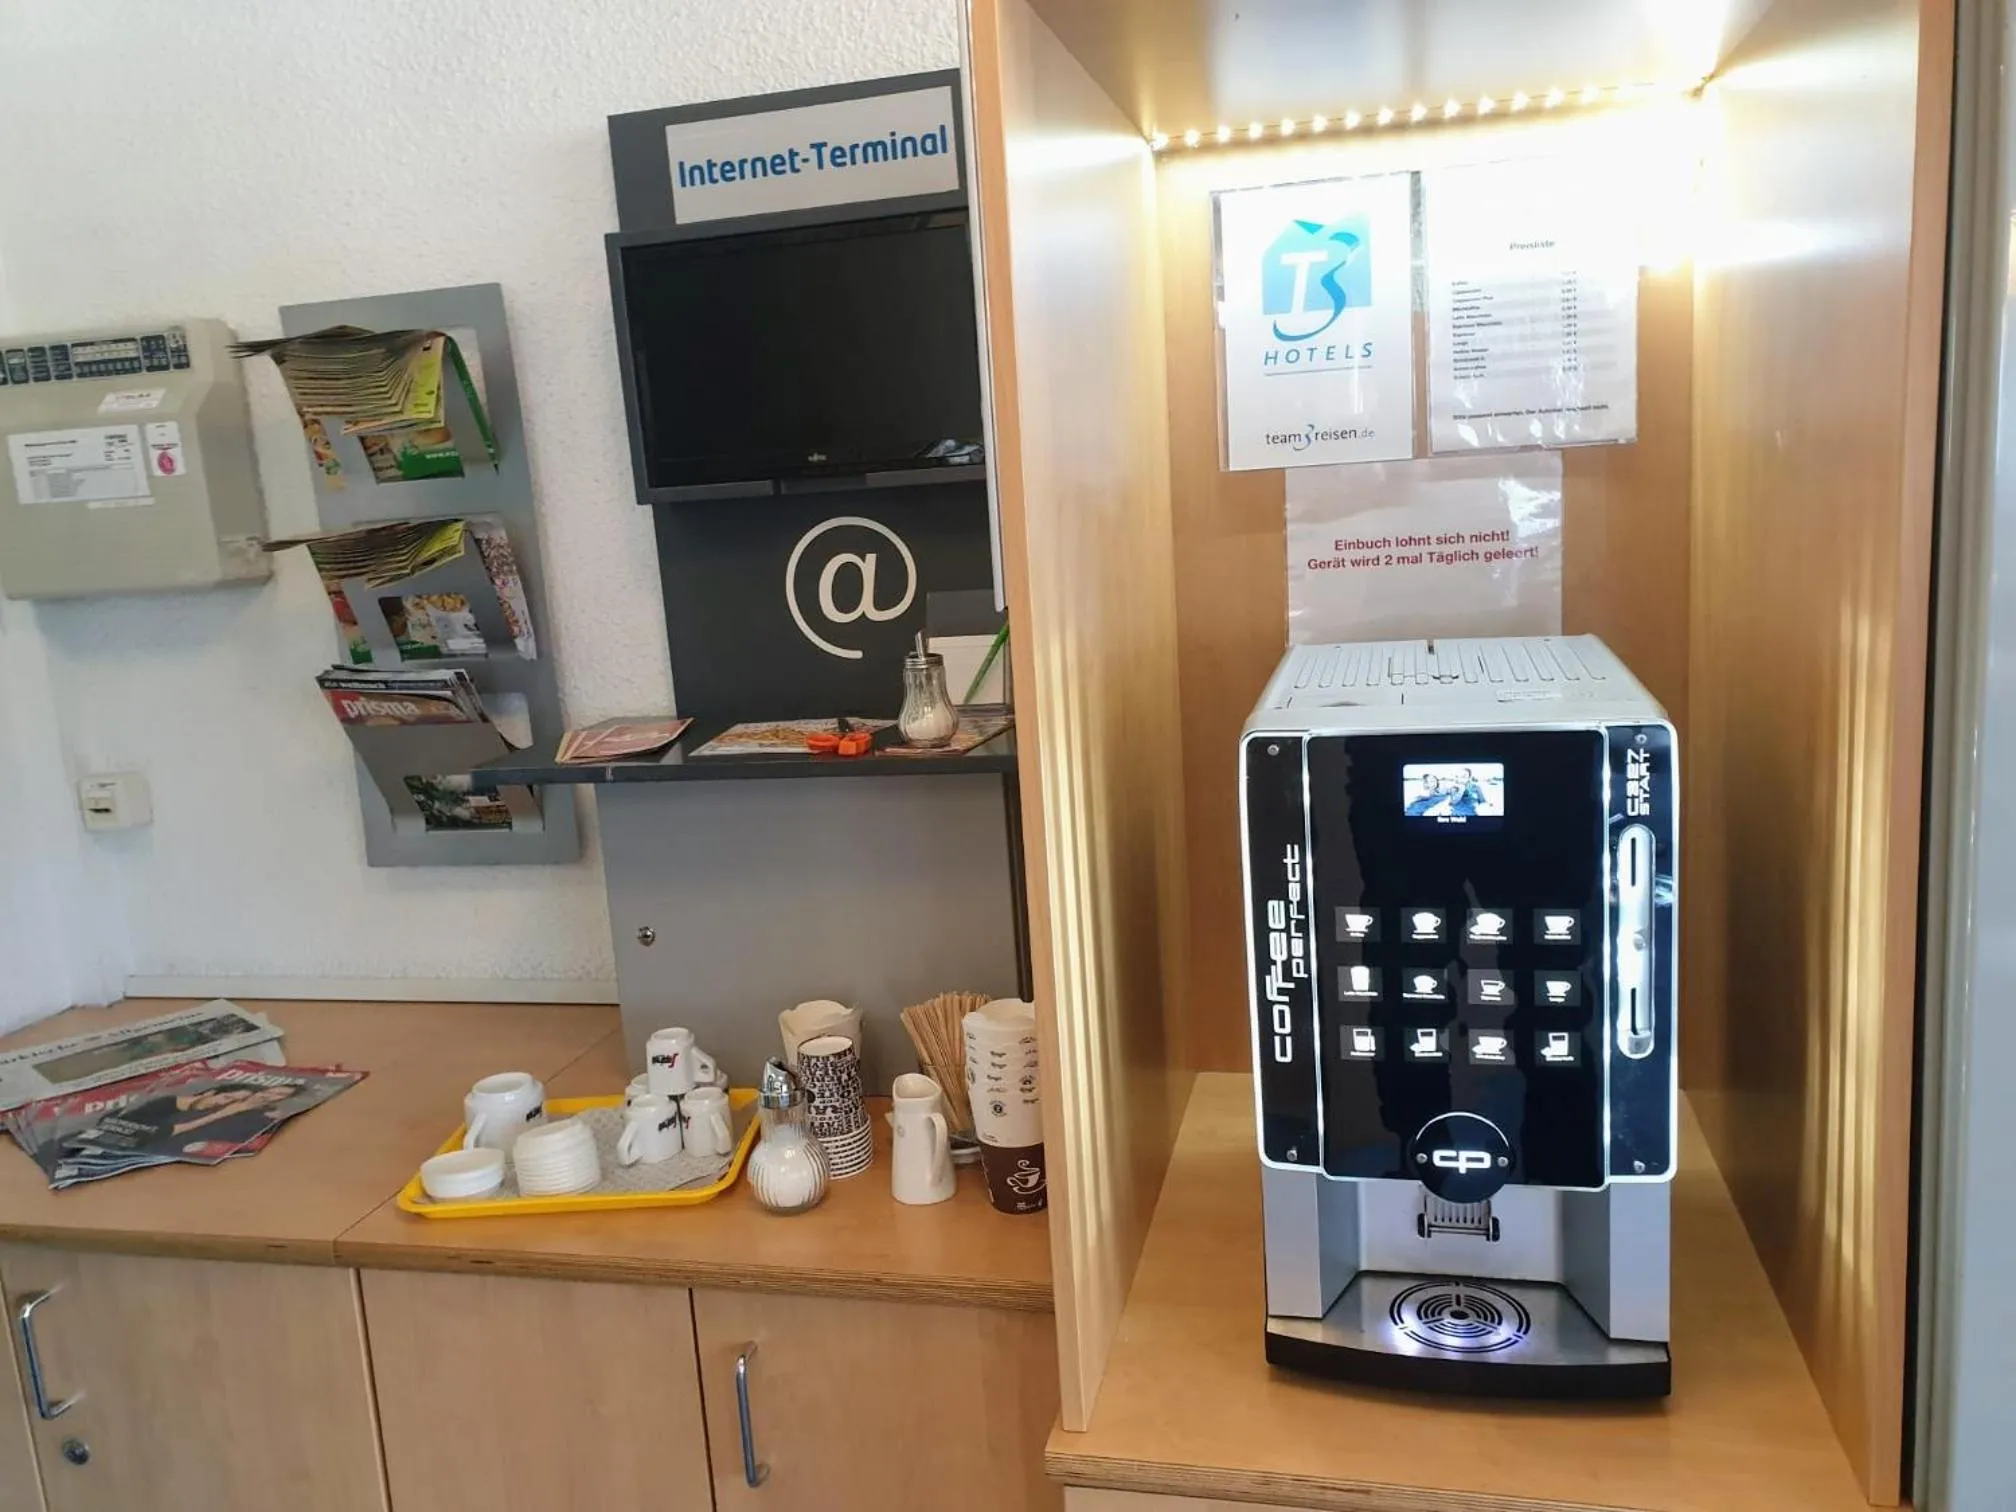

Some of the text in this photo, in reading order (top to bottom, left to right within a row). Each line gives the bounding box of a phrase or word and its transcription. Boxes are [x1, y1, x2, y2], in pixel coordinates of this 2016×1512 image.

[679, 125, 949, 187] Internet-Terminal
[1264, 342, 1373, 366] HOTELS
[1334, 530, 1510, 551] Einbuch lohnt sich nicht!
[1307, 557, 1346, 570] Gerät
[1350, 555, 1380, 568] wird
[1384, 554, 1393, 566] 2
[1397, 553, 1423, 565] mal
[1428, 550, 1479, 566] Täglich
[342, 696, 421, 718] prisma
[1640, 748, 1650, 816] START
[1283, 844, 1308, 978] perfect
[1265, 900, 1295, 1063] coffee
[1432, 1150, 1492, 1174] cp
